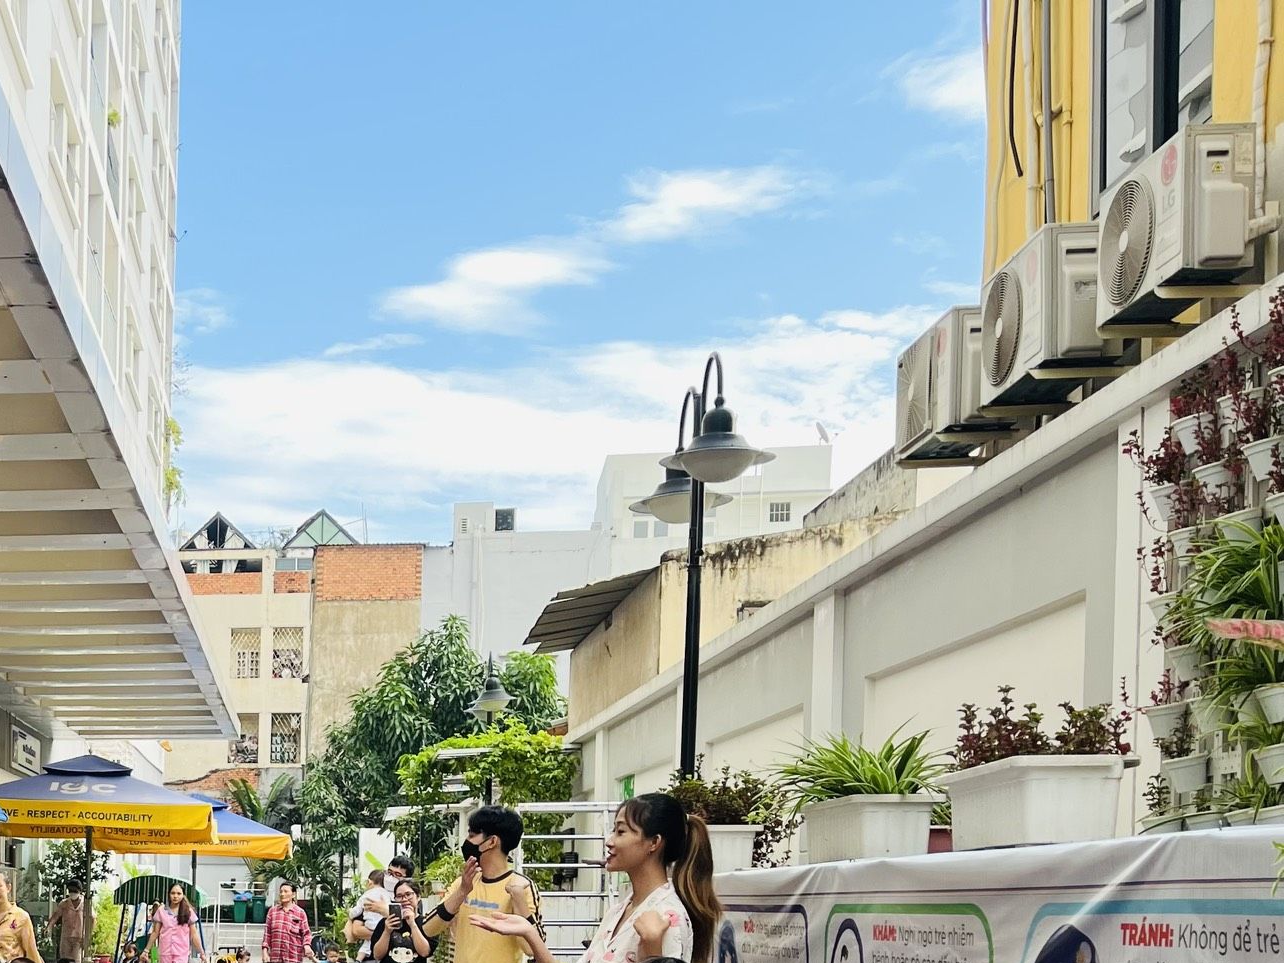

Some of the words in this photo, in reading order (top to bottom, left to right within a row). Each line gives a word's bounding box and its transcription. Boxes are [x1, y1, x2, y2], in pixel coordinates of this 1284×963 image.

[3, 809, 18, 818] OVE
[27, 809, 71, 819] RESPECT
[78, 811, 153, 823] ACCOUTABILITY
[1120, 916, 1174, 948] TRÁNH:
[1178, 923, 1228, 955] Không
[1232, 919, 1252, 952] để
[1257, 922, 1280, 954] trẻ
